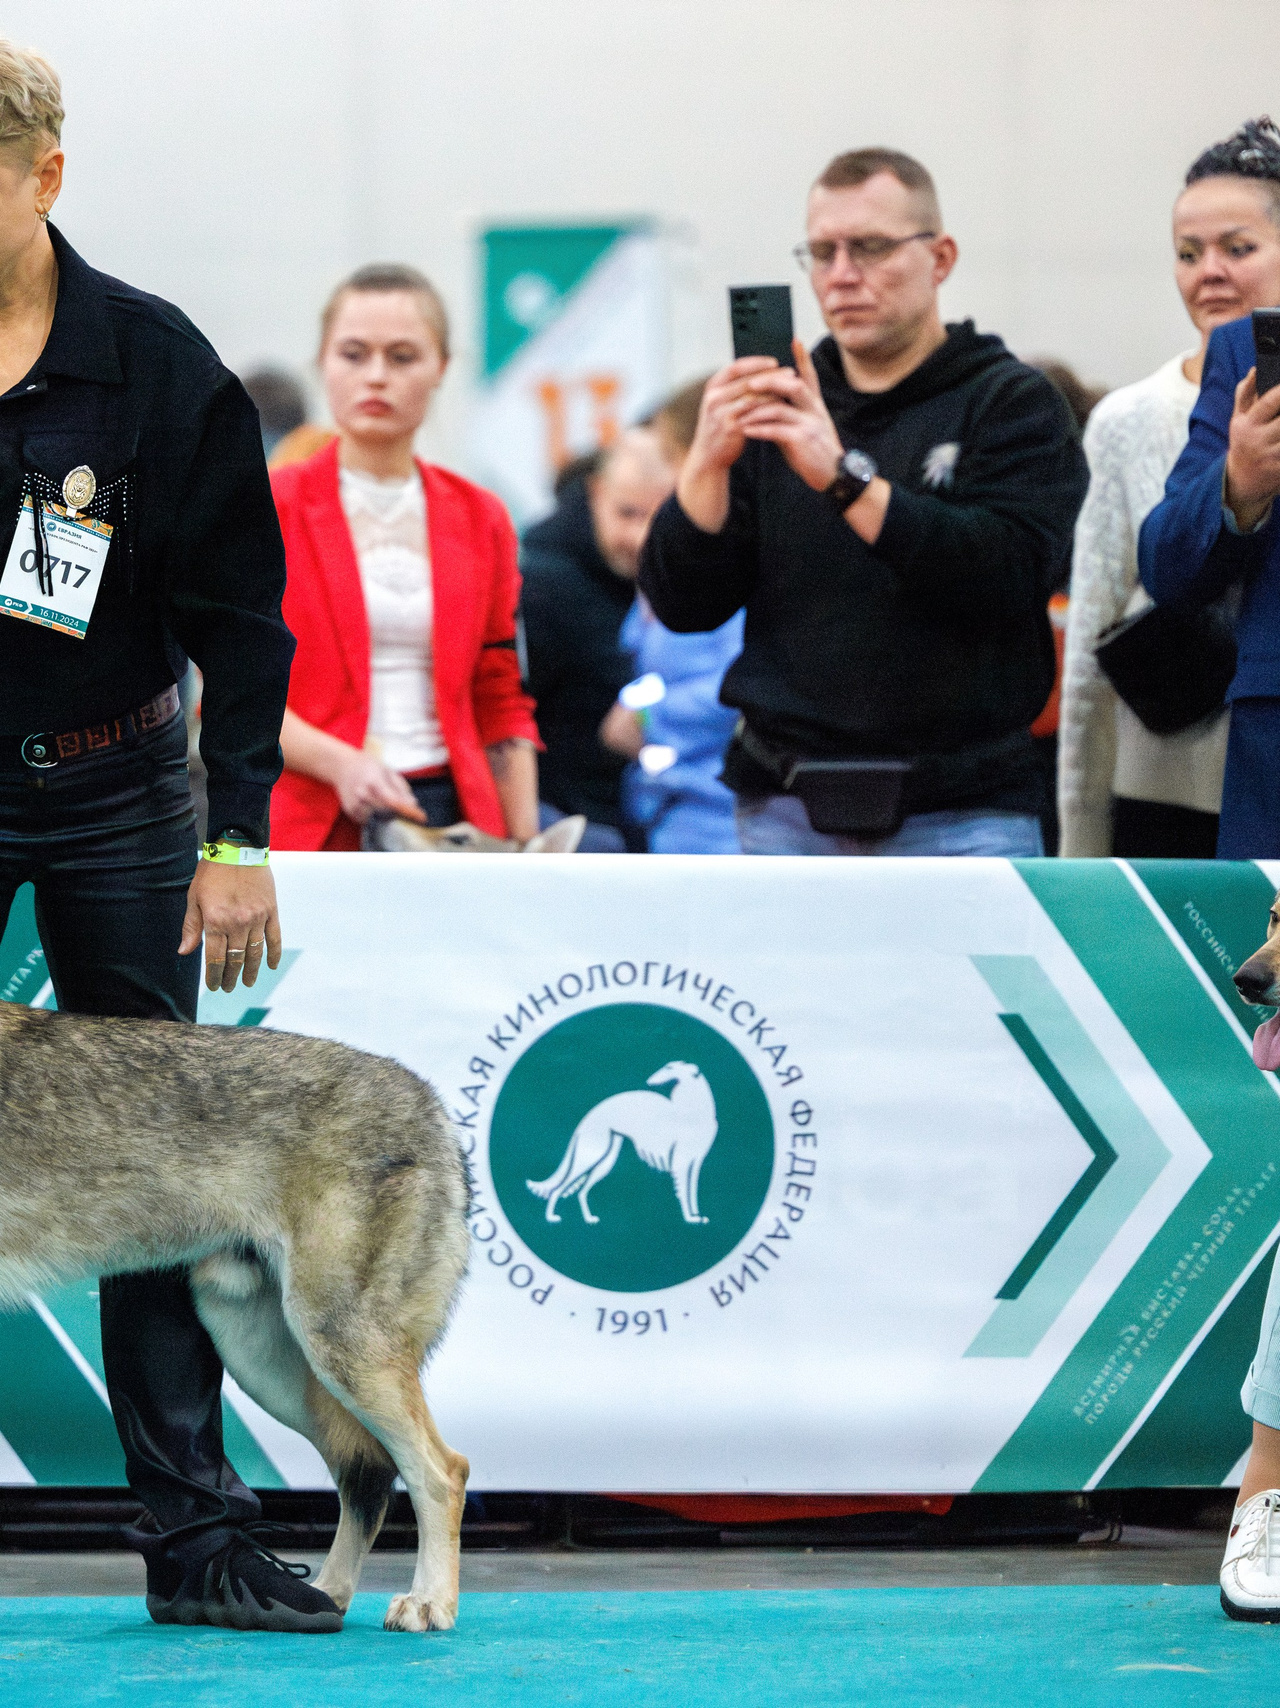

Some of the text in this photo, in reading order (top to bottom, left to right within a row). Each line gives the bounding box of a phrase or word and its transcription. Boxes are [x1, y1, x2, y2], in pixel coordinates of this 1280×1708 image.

[20, 549, 92, 589] 0717
[40, 608, 80, 627] 16.11.2024
[487, 961, 805, 1088] КИНОЛОГИЧЕСКАЯ
[710, 1098, 818, 1308] ФЕДЕРАЦИЯ
[595, 1307, 670, 1335] 1991
